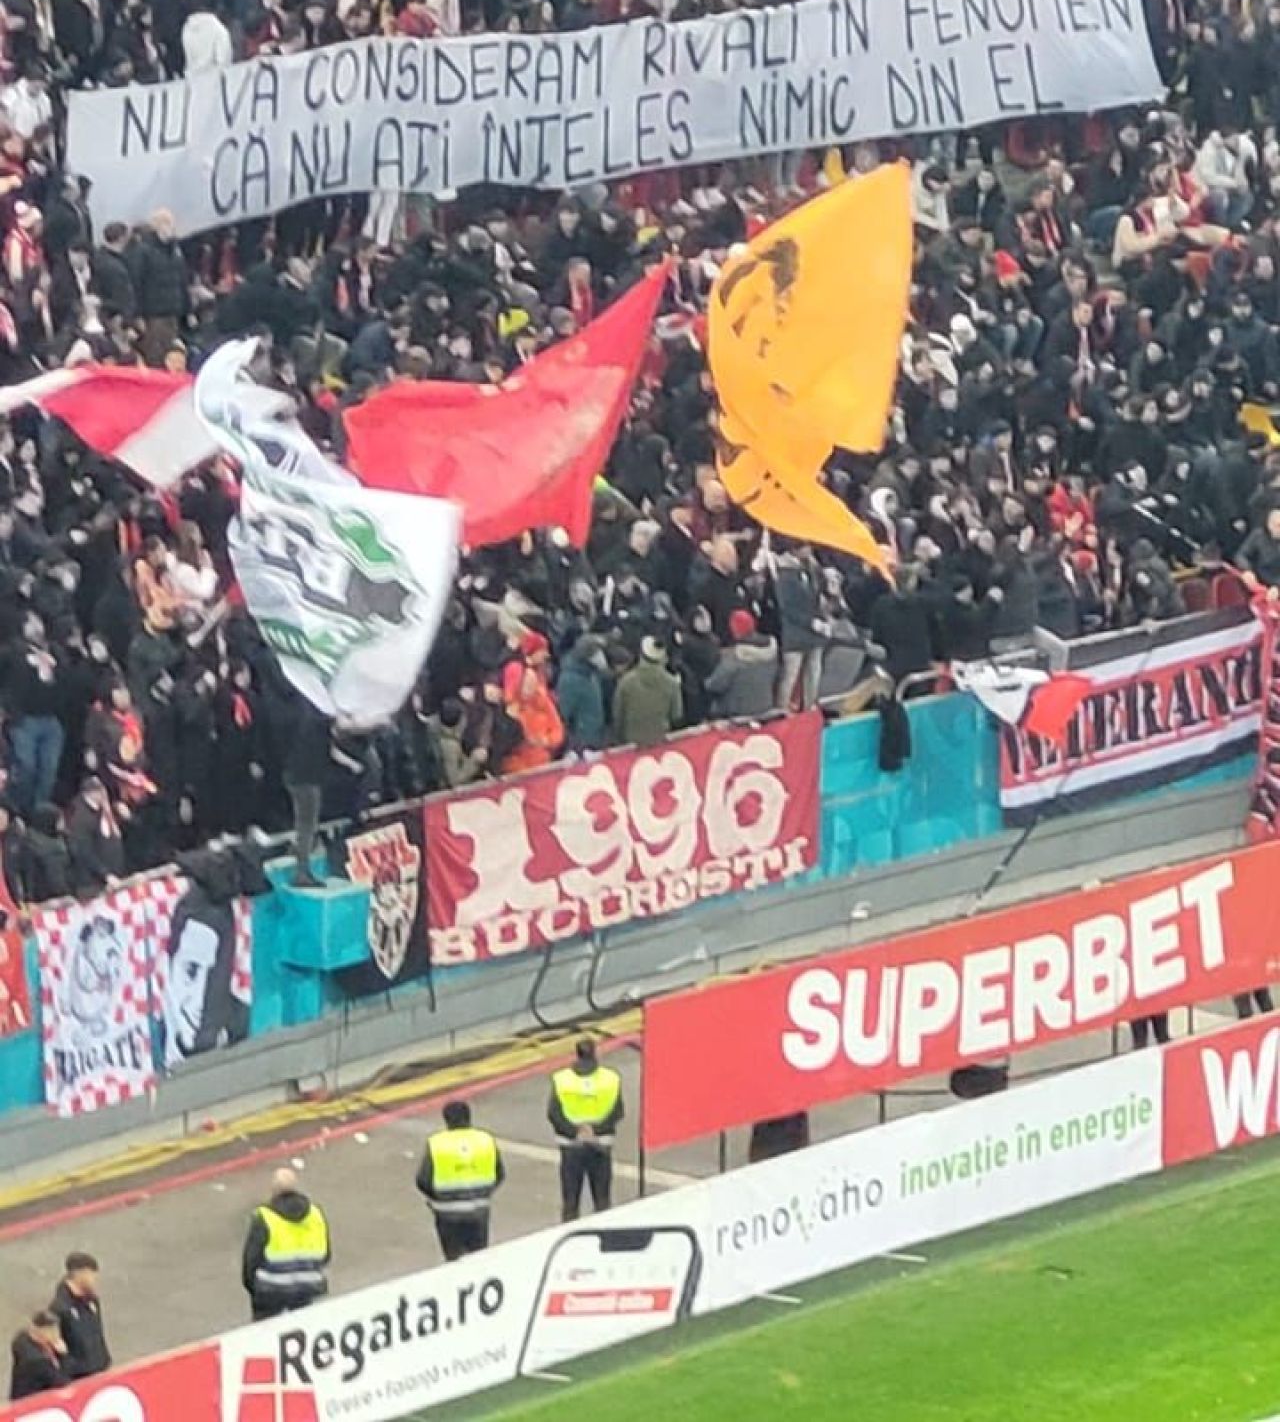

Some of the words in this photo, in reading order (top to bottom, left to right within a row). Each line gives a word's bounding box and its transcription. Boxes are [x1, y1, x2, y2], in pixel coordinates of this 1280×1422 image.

[121, 84, 190, 158] NU
[642, 4, 798, 85] RIVALI
[211, 126, 271, 216] CĂ
[289, 120, 350, 200] NU
[987, 42, 1064, 114] EL
[445, 733, 790, 926] 1996
[782, 861, 1235, 1071] SUPERBET
[1015, 1122, 1042, 1163] în
[1049, 1093, 1153, 1152] energie
[279, 1277, 504, 1384] Regata.ro
